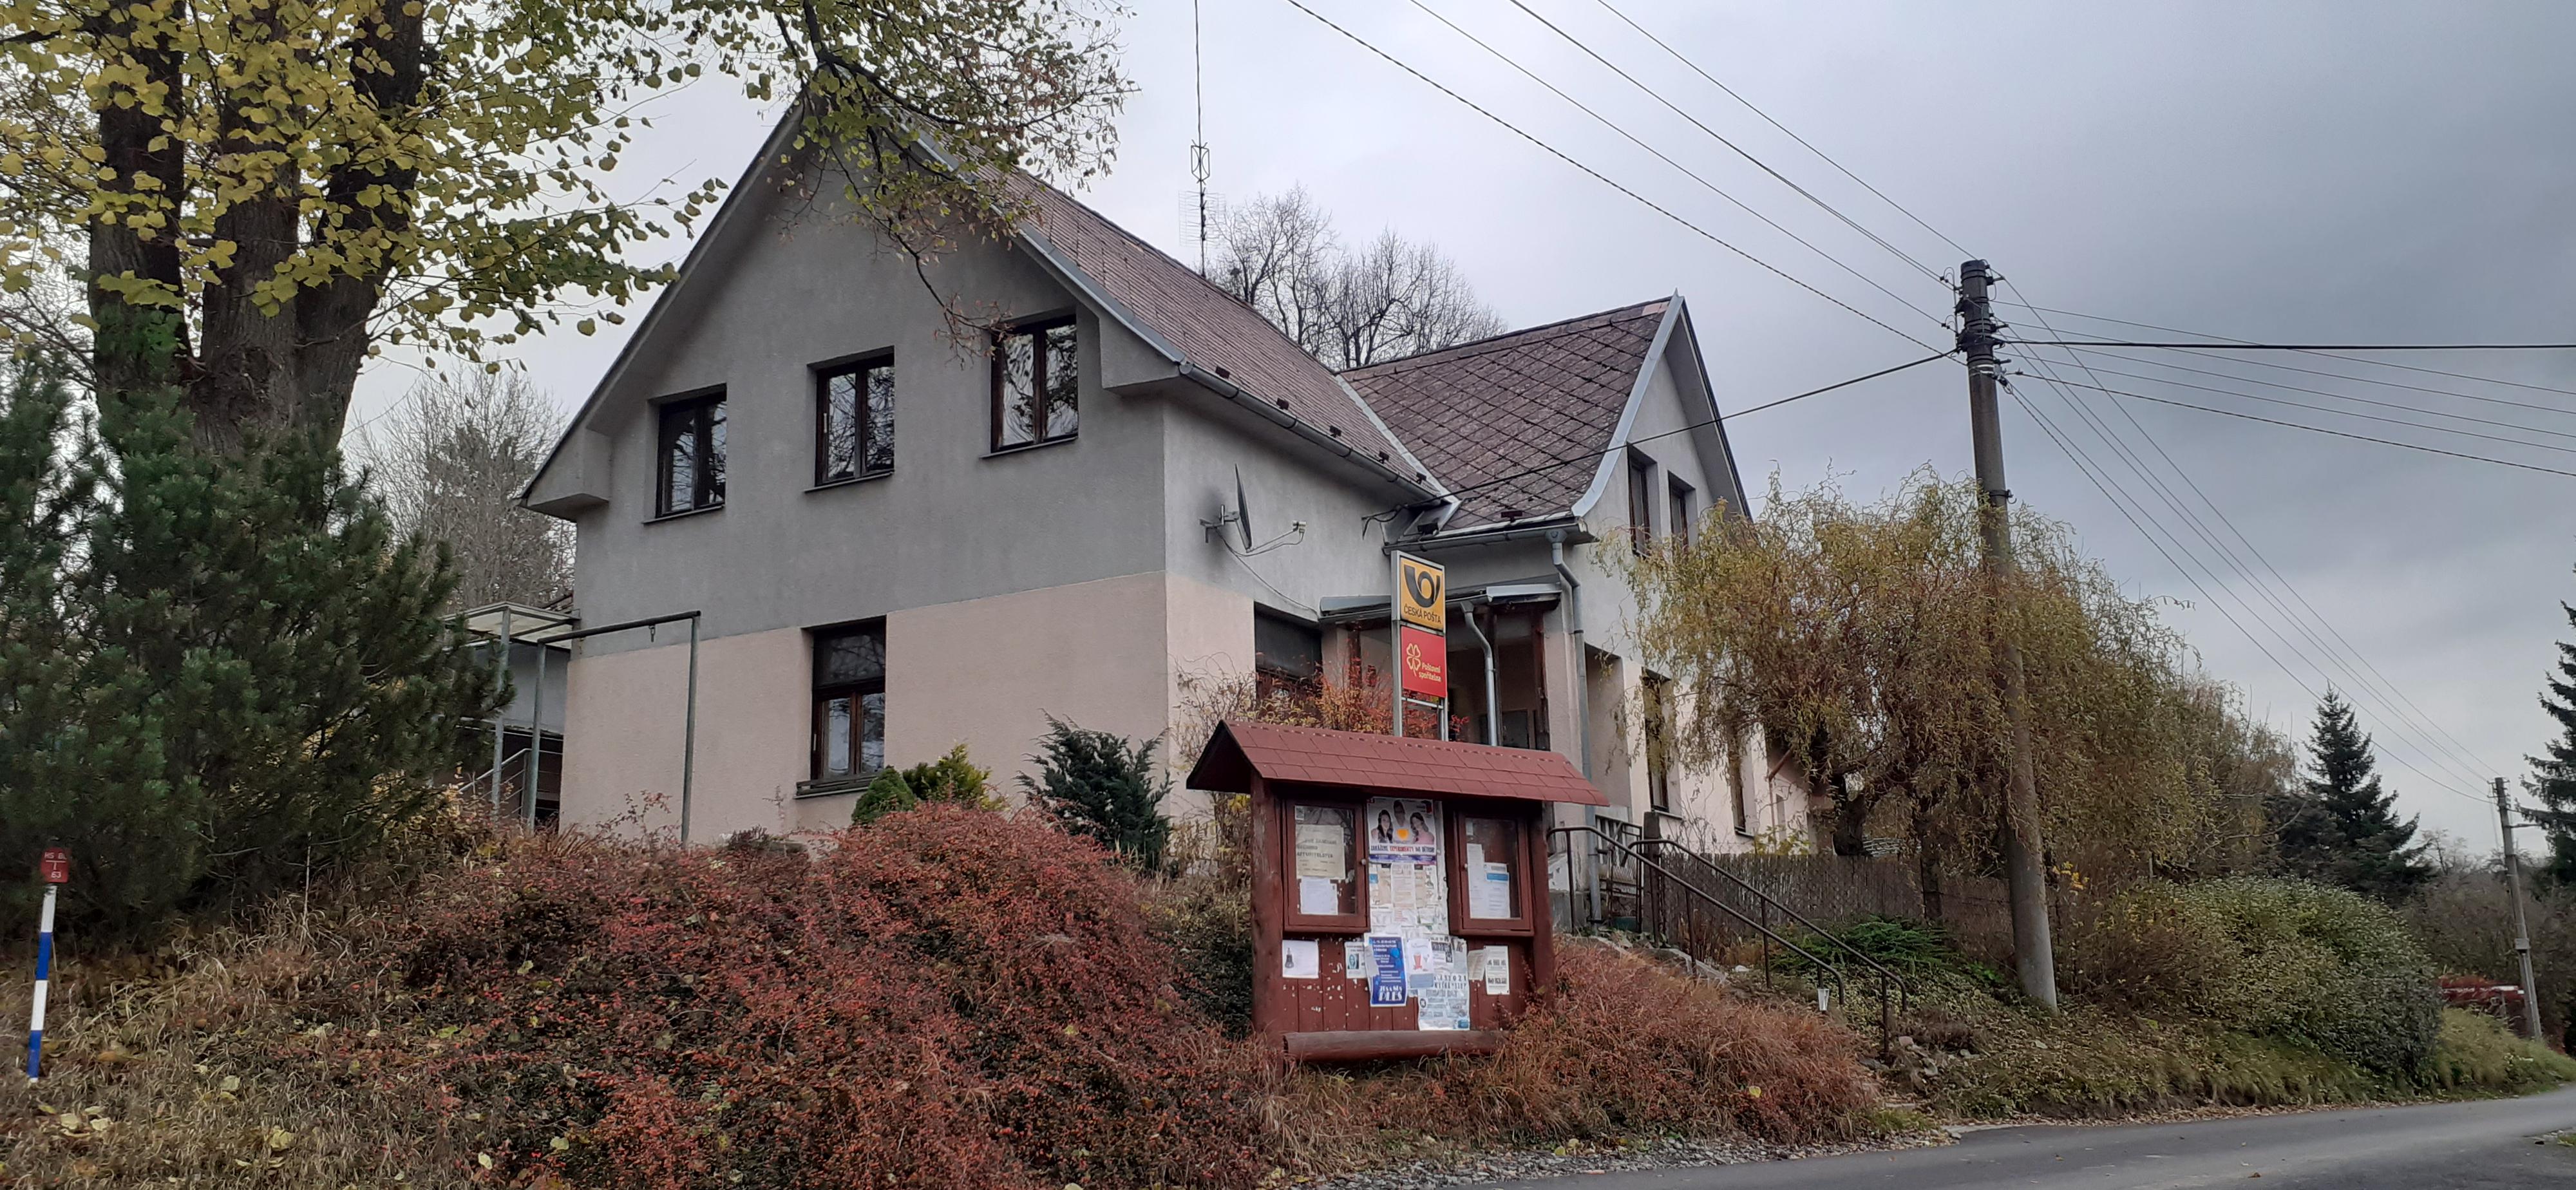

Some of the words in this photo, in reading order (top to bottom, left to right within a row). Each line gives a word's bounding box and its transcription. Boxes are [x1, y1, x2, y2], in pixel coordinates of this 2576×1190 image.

[1404, 603, 1423, 619] ČESKÁ
[1423, 610, 1441, 624] POŠTA
[1421, 663, 1441, 674] Poštovní
[1419, 671, 1442, 683] spořitelna
